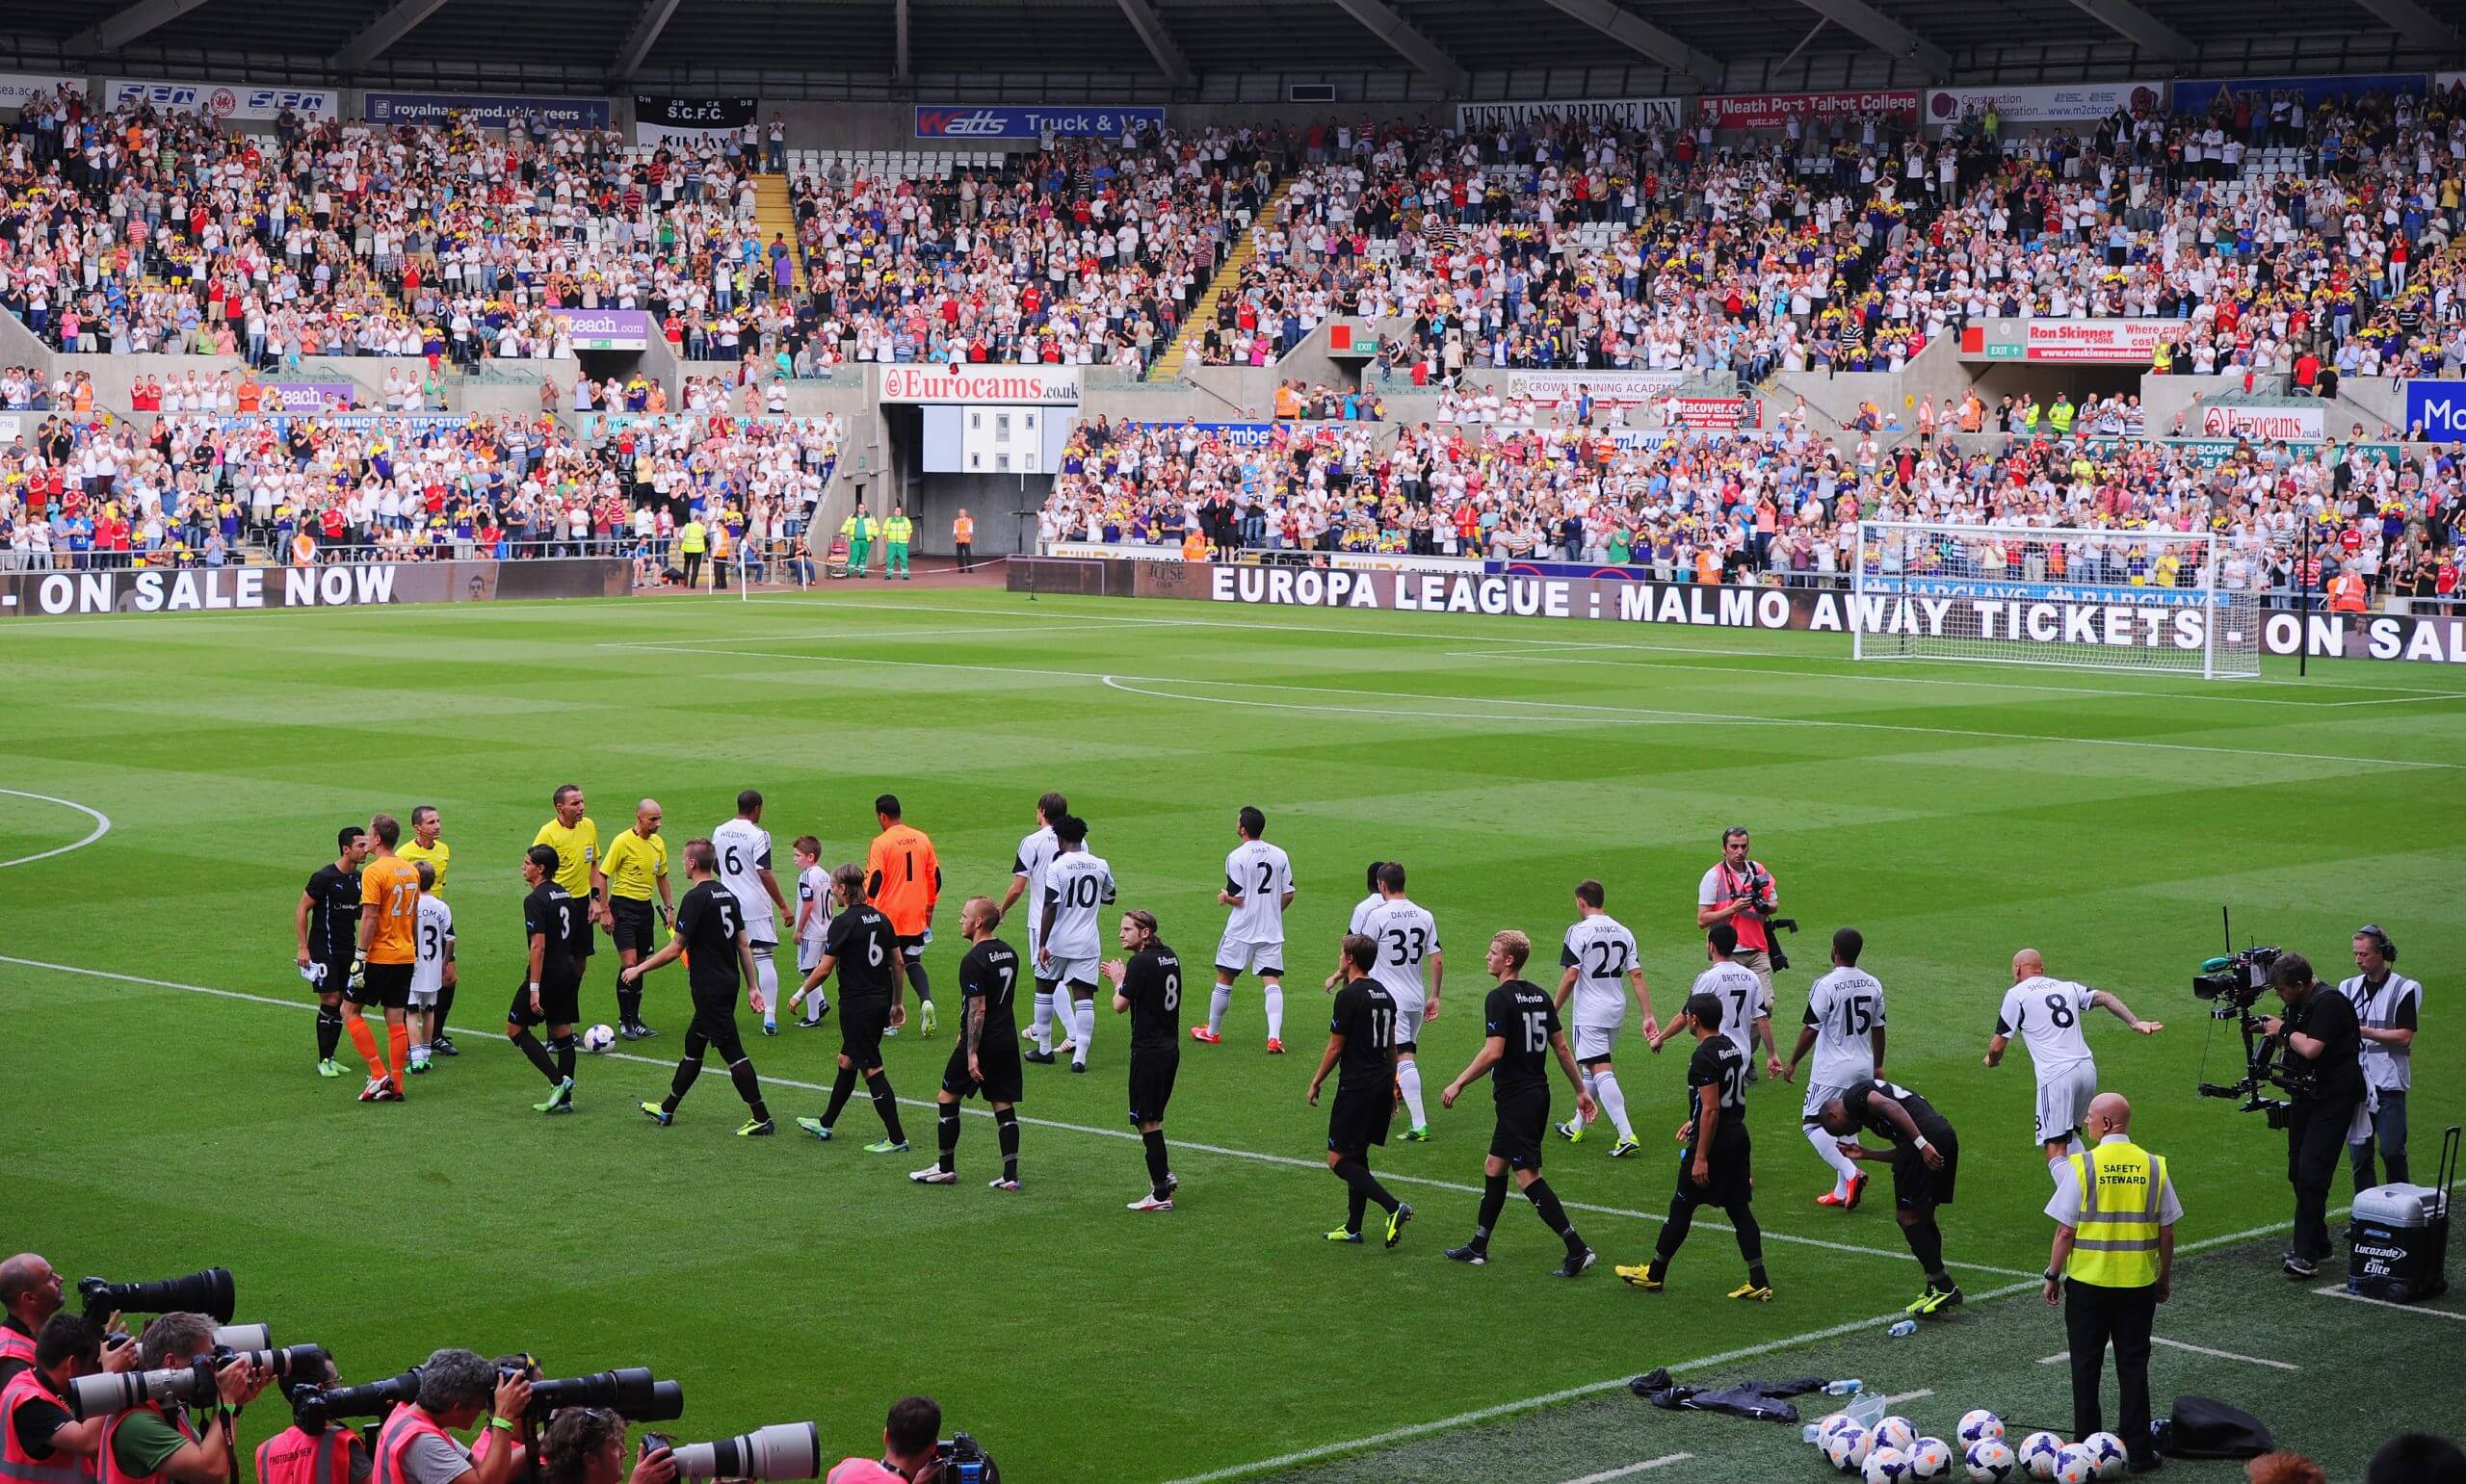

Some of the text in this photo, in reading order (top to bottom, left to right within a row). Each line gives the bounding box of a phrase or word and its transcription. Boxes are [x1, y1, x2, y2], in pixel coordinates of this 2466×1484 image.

[668, 107, 724, 119] S.C.F.C.
[1643, 101, 1676, 129] INN
[1722, 98, 1767, 114] Neath
[1861, 93, 1916, 111] College
[918, 110, 1009, 135] Watts
[1026, 114, 1089, 131] Truck
[1097, 115, 1112, 131] &
[2030, 325, 2113, 339] Ron Skinner
[2125, 324, 2159, 334] Where
[1357, 342, 1372, 351] EXIT
[1991, 346, 2007, 355] EXIT
[1529, 382, 1569, 393] CROWN
[1573, 382, 1622, 393] TAINING
[39, 573, 112, 614] ON
[135, 570, 264, 612] SALE
[285, 565, 396, 606] NOW
[1212, 566, 1378, 608] EUROPA
[1395, 574, 1570, 618] LEAGUE
[1619, 585, 1791, 629] MALMO
[1809, 592, 1954, 637] AWAY
[1973, 599, 2206, 650] TICKETS
[2265, 612, 2344, 658] ON
[897, 838, 917, 846] VORM
[724, 845, 744, 875] 6
[905, 849, 913, 882] 1
[1065, 874, 1098, 908] 10
[1256, 861, 1272, 895] 2
[391, 882, 419, 917] 27
[1390, 910, 1419, 920] DAVIES
[559, 905, 570, 940] 3
[720, 904, 735, 939] 5
[423, 924, 438, 961] 3
[868, 930, 883, 967] 6
[1388, 927, 1425, 966] 33
[1591, 941, 1628, 978] 22
[999, 967, 1013, 1004] 7
[1164, 974, 1178, 1011] 8
[1721, 974, 1751, 982] BRITTON
[1834, 978, 1876, 991] ROUTLEDGE
[1730, 989, 1746, 1028] 7
[1844, 995, 1872, 1036] 15
[2045, 993, 2075, 1029] 8
[1372, 1008, 1391, 1048] 11
[1522, 1011, 1547, 1053] 15
[2099, 1176, 2146, 1185] STEWARD
[2104, 1164, 2141, 1173] SAFETY
[2355, 1242, 2398, 1259] Lucozade
[2364, 1263, 2390, 1276] Elite
